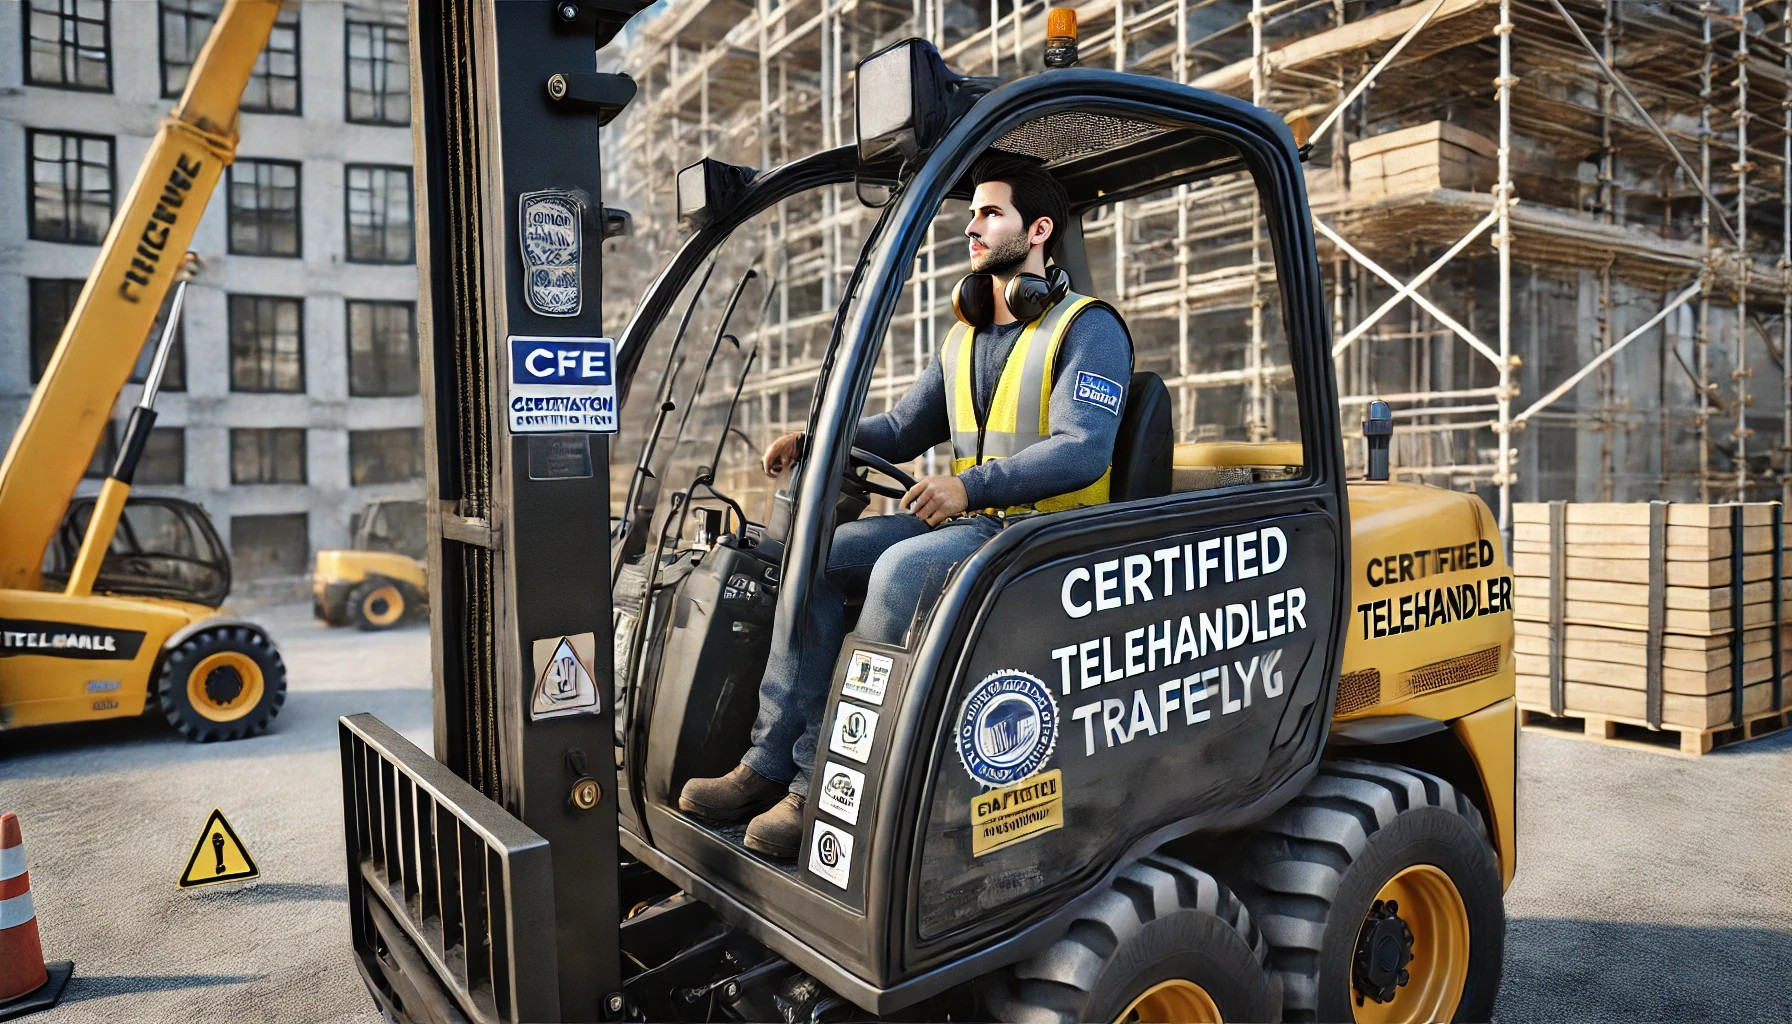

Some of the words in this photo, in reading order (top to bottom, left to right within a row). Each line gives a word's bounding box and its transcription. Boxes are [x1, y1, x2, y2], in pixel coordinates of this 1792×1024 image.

[525, 348, 606, 377] CFE
[1061, 526, 1288, 619] CERTIFIED
[1357, 576, 1512, 640] TELEHANDLER
[1052, 587, 1306, 695] TELEHANDLER
